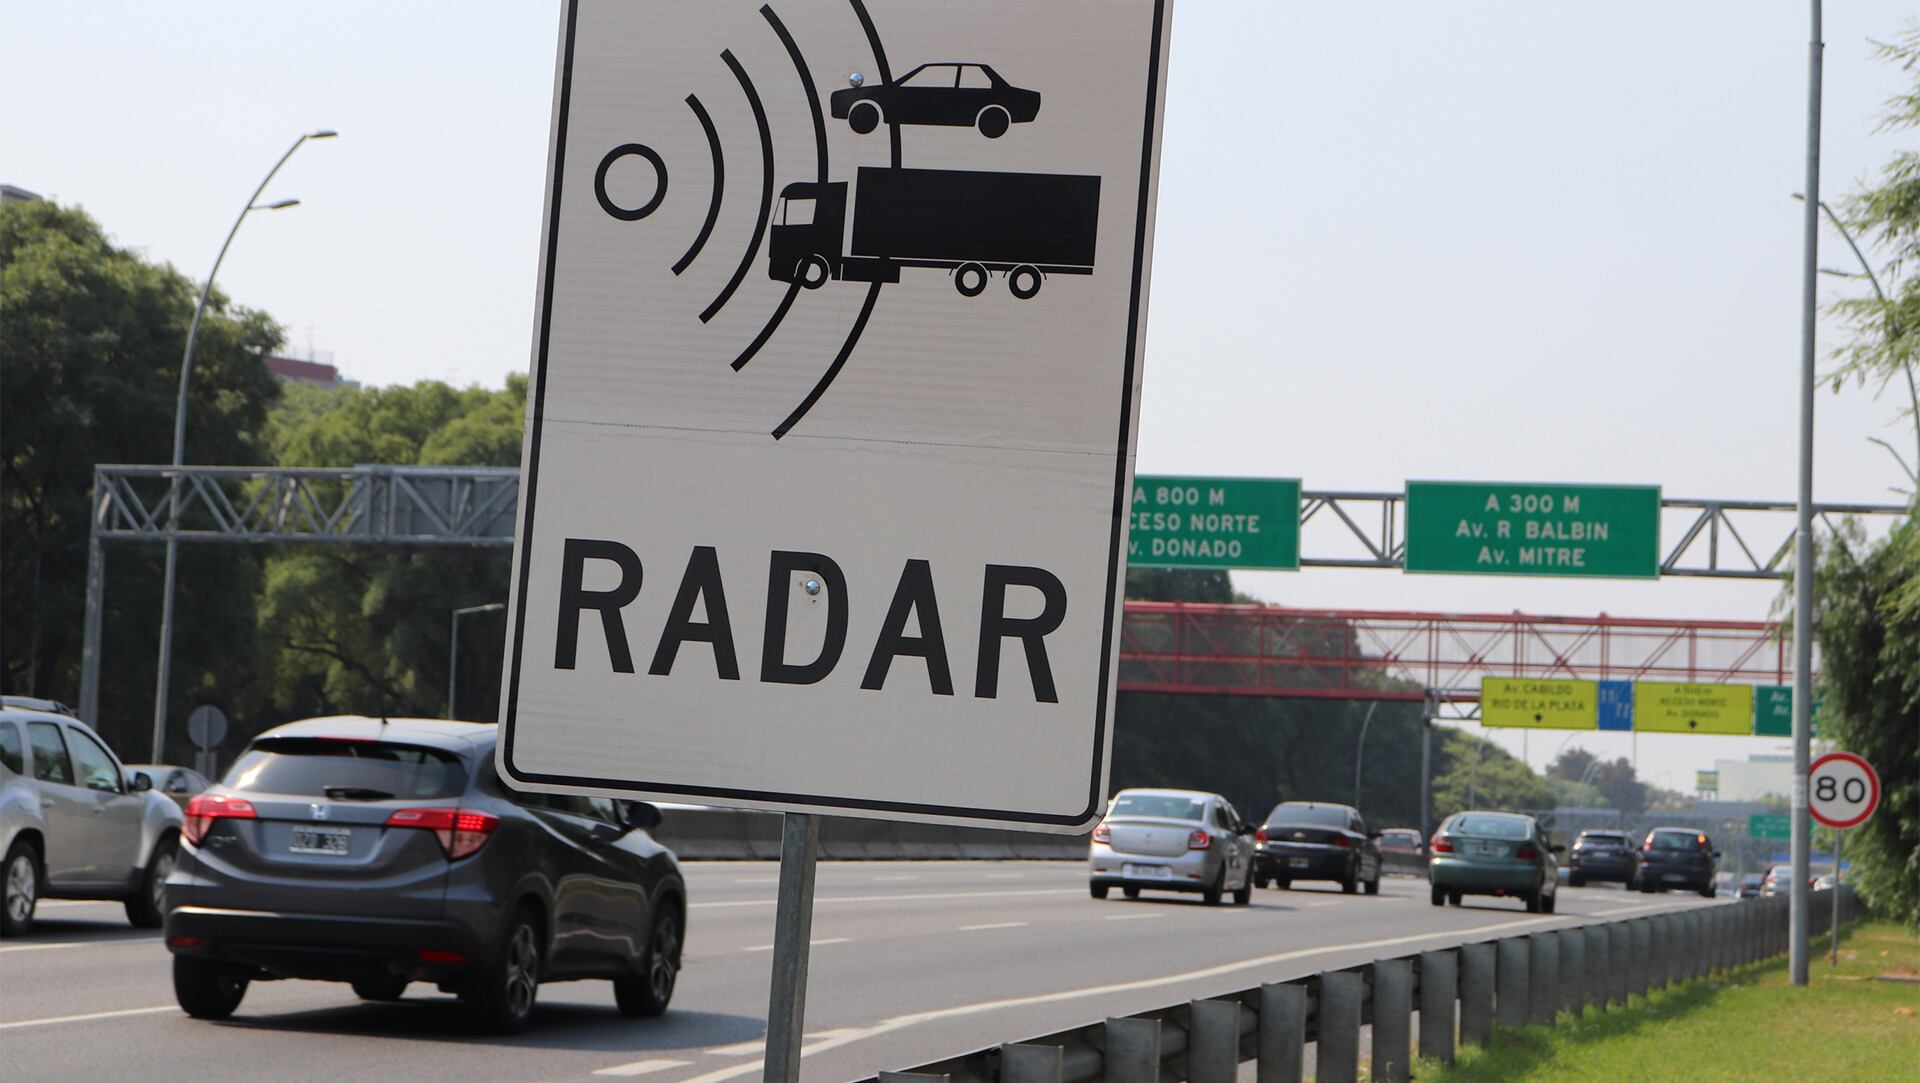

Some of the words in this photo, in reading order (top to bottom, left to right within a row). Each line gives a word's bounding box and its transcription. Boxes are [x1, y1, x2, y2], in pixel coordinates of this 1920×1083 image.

[1156, 487, 1199, 505] 800
[1209, 488, 1224, 506] M
[1485, 494, 1500, 512] A
[1509, 495, 1553, 514] 300
[1564, 495, 1580, 514] M
[1190, 514, 1260, 533] NORTE
[1497, 520, 1511, 539] R
[1526, 521, 1609, 541] BALBIN
[1152, 538, 1242, 558] DONADO
[1519, 547, 1585, 567] MITRE
[554, 538, 1068, 704] RADAR
[1523, 684, 1573, 695] CABILDO
[1514, 700, 1528, 710] DE
[1530, 700, 1546, 711] LA
[1549, 701, 1585, 712] PLATA
[1816, 776, 1866, 803] 80
